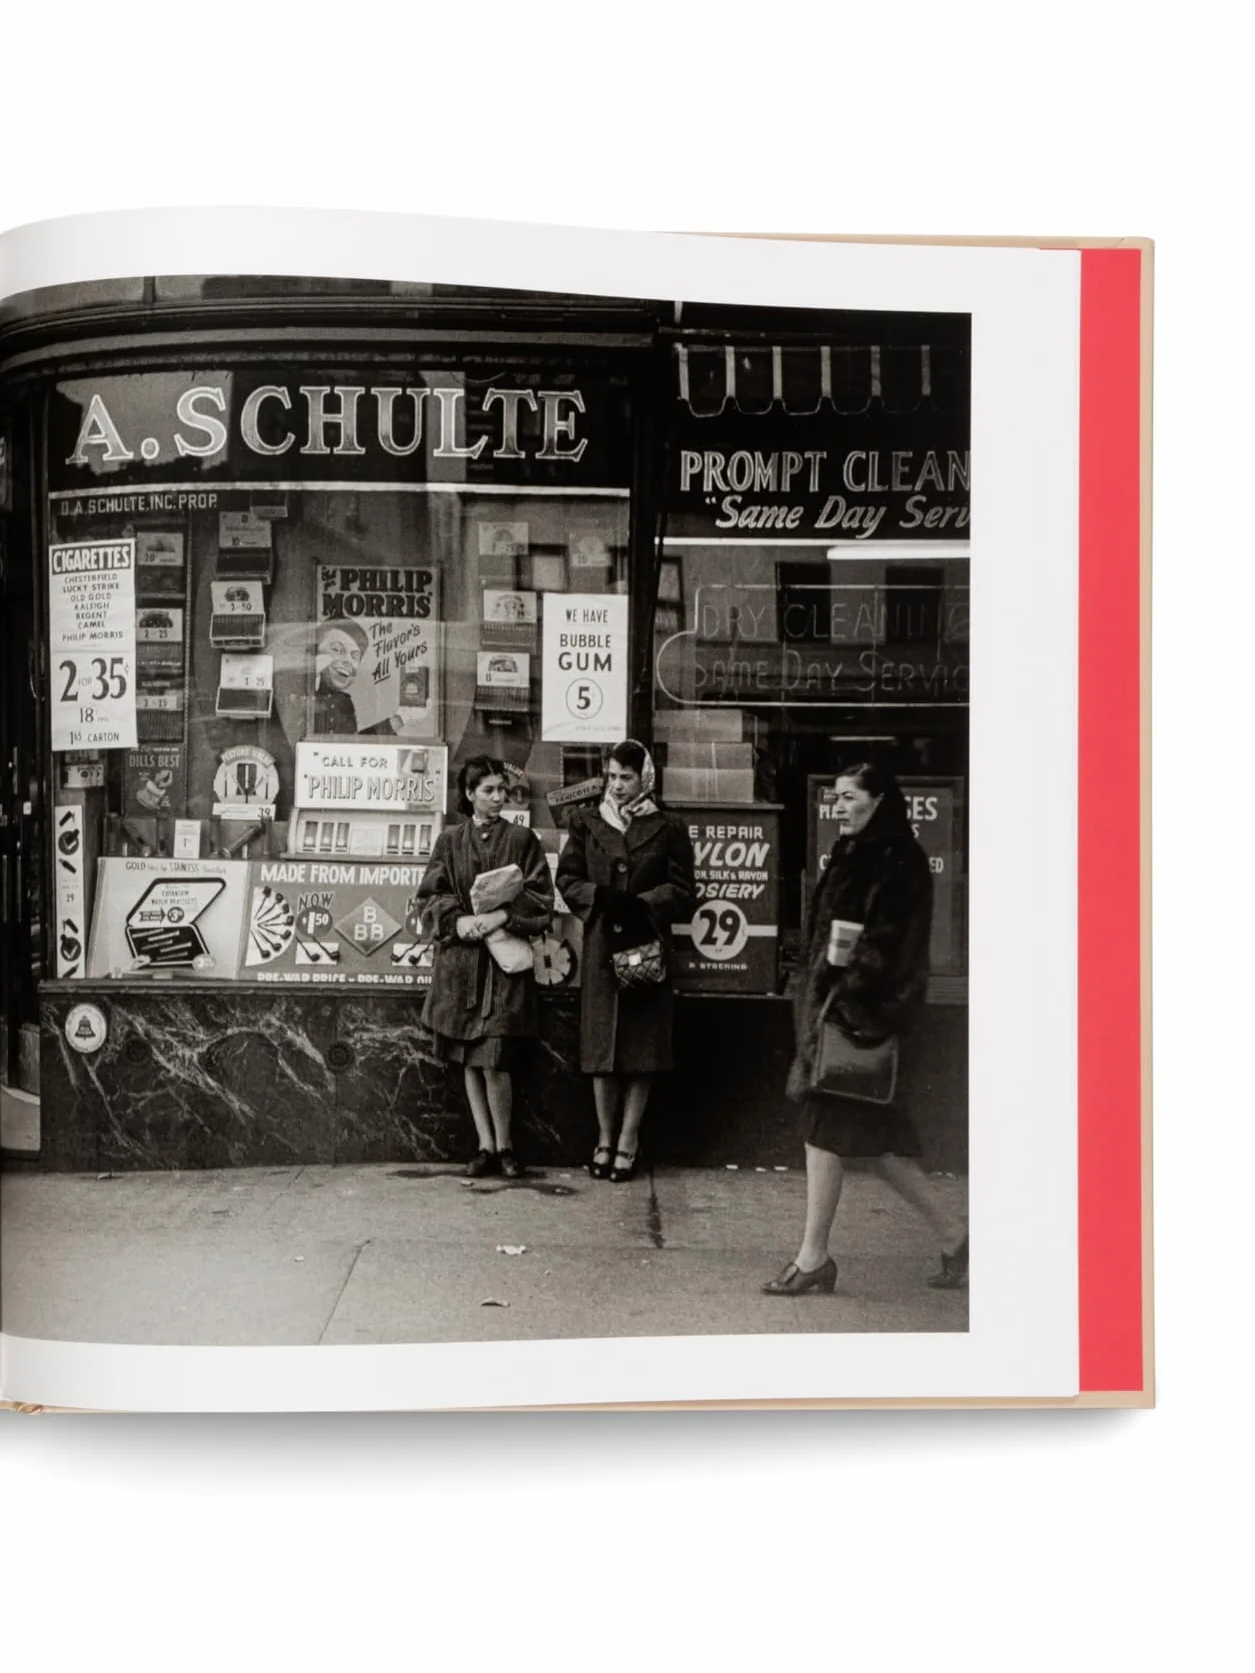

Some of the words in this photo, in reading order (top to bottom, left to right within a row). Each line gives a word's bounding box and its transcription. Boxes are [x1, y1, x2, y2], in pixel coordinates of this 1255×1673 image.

[173, 385, 589, 463] SCHULTE
[679, 450, 828, 493] PROMPT
[843, 450, 971, 493] CLEAN
[813, 494, 888, 540] Day
[52, 545, 131, 574] CIGARETTES
[64, 573, 118, 584] CHESTERFIELD
[339, 567, 434, 594] PHILIP
[62, 584, 88, 594] LUCKY
[91, 582, 120, 592] STRIKE
[70, 594, 86, 603] OLD
[88, 592, 112, 602] GOLD
[74, 602, 110, 611] RALEIGH
[75, 611, 107, 620] REGENT
[565, 608, 578, 624] WE
[582, 609, 609, 624] HAVE
[702, 603, 768, 640] DRY
[77, 620, 105, 630] CAMEL
[369, 621, 393, 641] The
[62, 633, 86, 642] PHILIP
[89, 630, 124, 640] MORRIS
[373, 624, 421, 658] Flavor's
[559, 633, 612, 649] BUBBLE
[372, 657, 391, 682] All
[394, 641, 429, 669] Yours
[558, 651, 612, 672] GUM
[58, 659, 79, 703] 2
[576, 686, 591, 711] 5
[79, 707, 95, 724] 18
[87, 732, 120, 743] CARTON
[157, 754, 180, 768] BEST
[360, 756, 389, 769] FOR
[688, 824, 699, 839] E
[705, 825, 764, 840] REPAIR
[692, 840, 771, 868] YLON
[125, 861, 146, 872] GOLD
[259, 863, 306, 882] MADE
[309, 864, 355, 885] FROM
[709, 870, 730, 881] SILK
[738, 870, 769, 882] RAYON
[695, 882, 765, 900] OSIERY
[296, 890, 336, 914] NOW
[363, 905, 378, 923] B
[699, 908, 742, 946] 29
